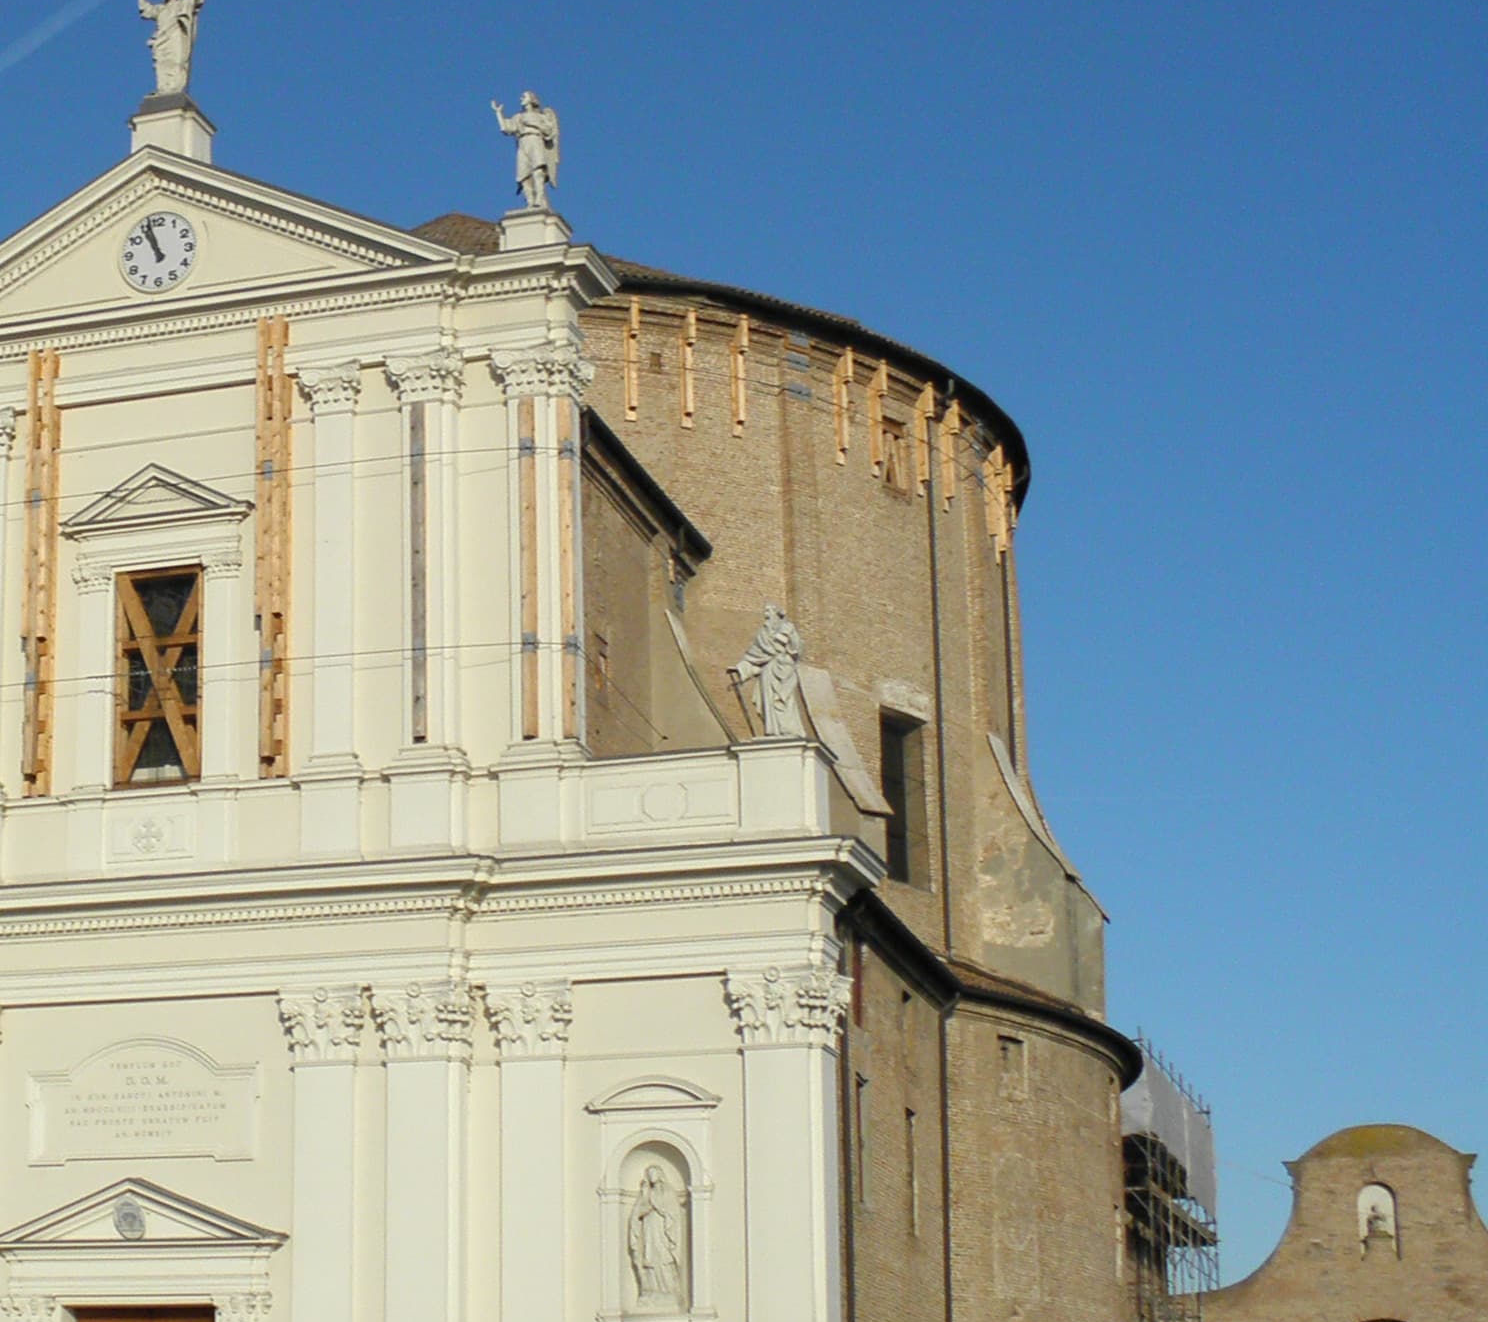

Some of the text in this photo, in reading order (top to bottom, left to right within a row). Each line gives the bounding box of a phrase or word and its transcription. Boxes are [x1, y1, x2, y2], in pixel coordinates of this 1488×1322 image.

[152, 217, 166, 227] 12
[171, 219, 177, 228] 1
[179, 228, 189, 239] 2
[129, 236, 143, 245] 10
[184, 242, 193, 252] 3
[124, 251, 134, 261] 9
[180, 258, 190, 268] 4
[129, 265, 138, 275] 8
[140, 274, 148, 285] 7
[168, 270, 178, 281] 5
[154, 277, 163, 287] 6
